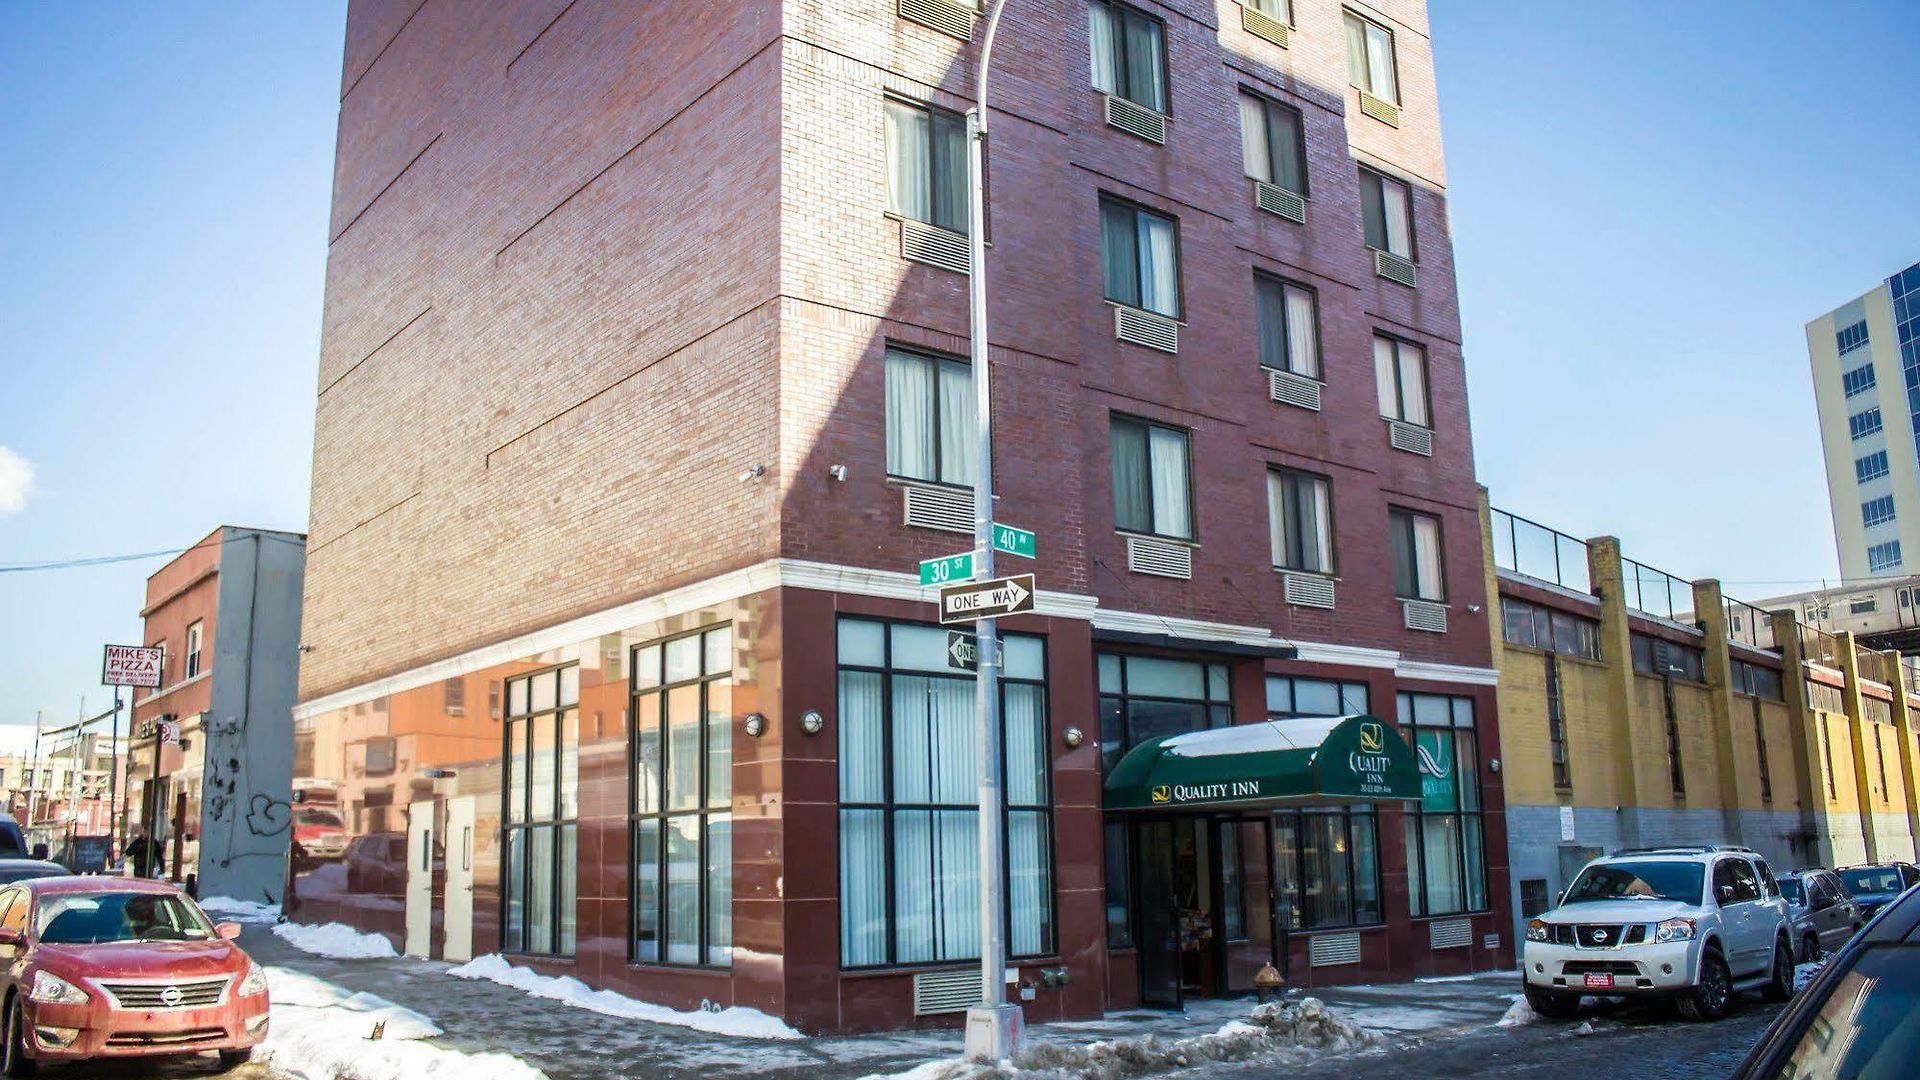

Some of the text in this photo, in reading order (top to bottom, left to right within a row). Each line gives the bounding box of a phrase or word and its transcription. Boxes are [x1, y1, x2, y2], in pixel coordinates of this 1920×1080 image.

[1000, 529, 1016, 550] 40
[931, 557, 964, 582] 30 ST
[954, 588, 1020, 610] ONE WAY
[108, 647, 159, 660] MIKE'S
[957, 644, 974, 661] ONE
[110, 659, 154, 671] PIZZA
[1367, 773, 1384, 783] INN
[1174, 780, 1259, 801] QUALITY INN
